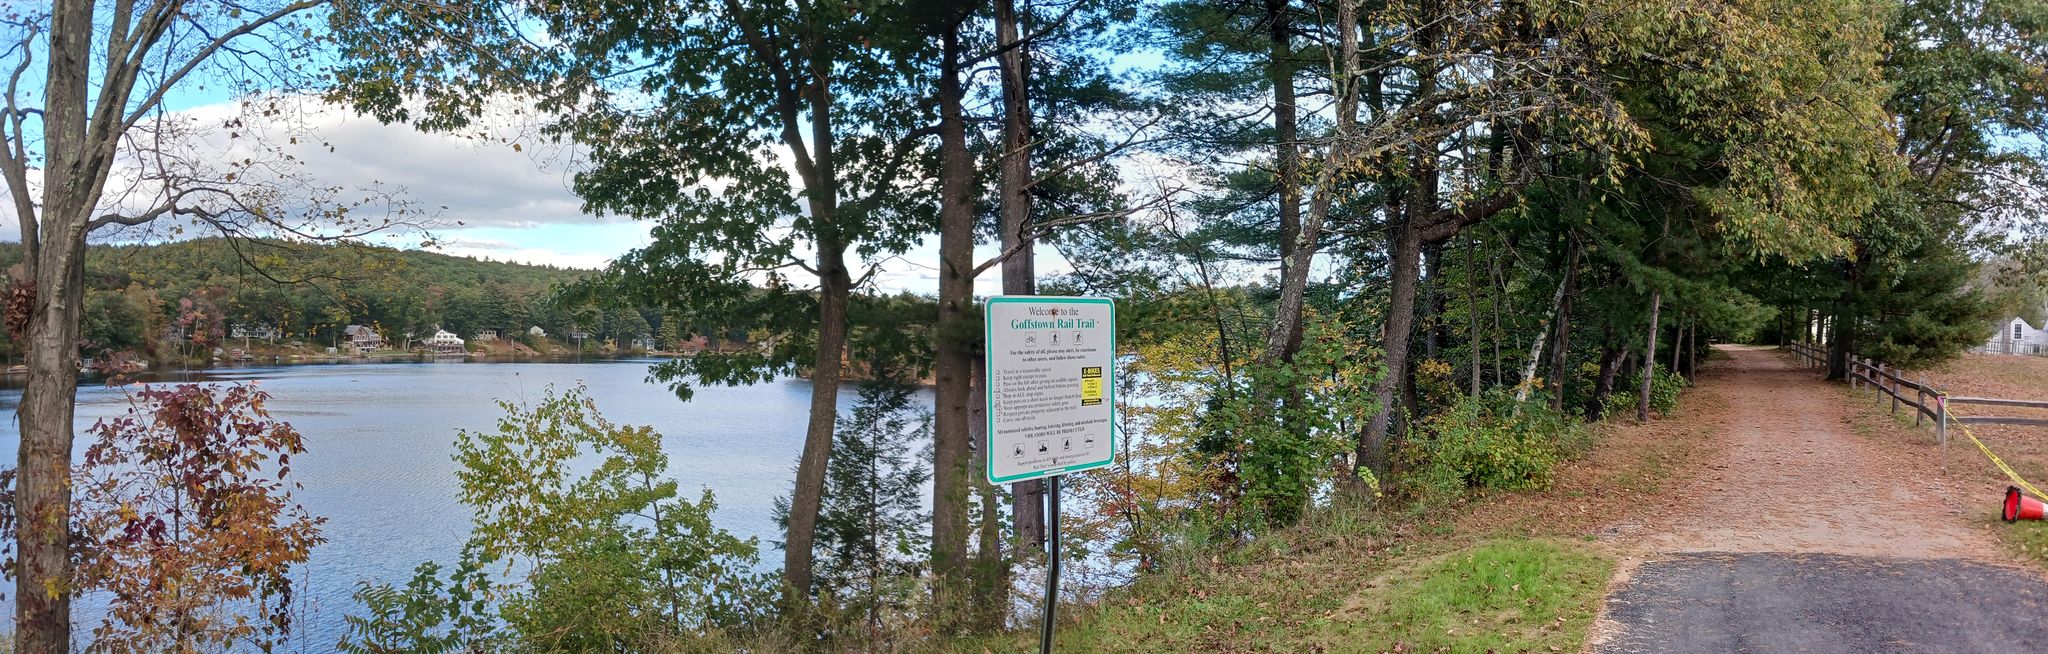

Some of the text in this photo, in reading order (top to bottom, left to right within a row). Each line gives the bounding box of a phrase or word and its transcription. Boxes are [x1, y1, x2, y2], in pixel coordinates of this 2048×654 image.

[1060, 308, 1067, 316] to
[1069, 307, 1080, 316] the
[1011, 318, 1095, 330] Goffstown Rail Trail
